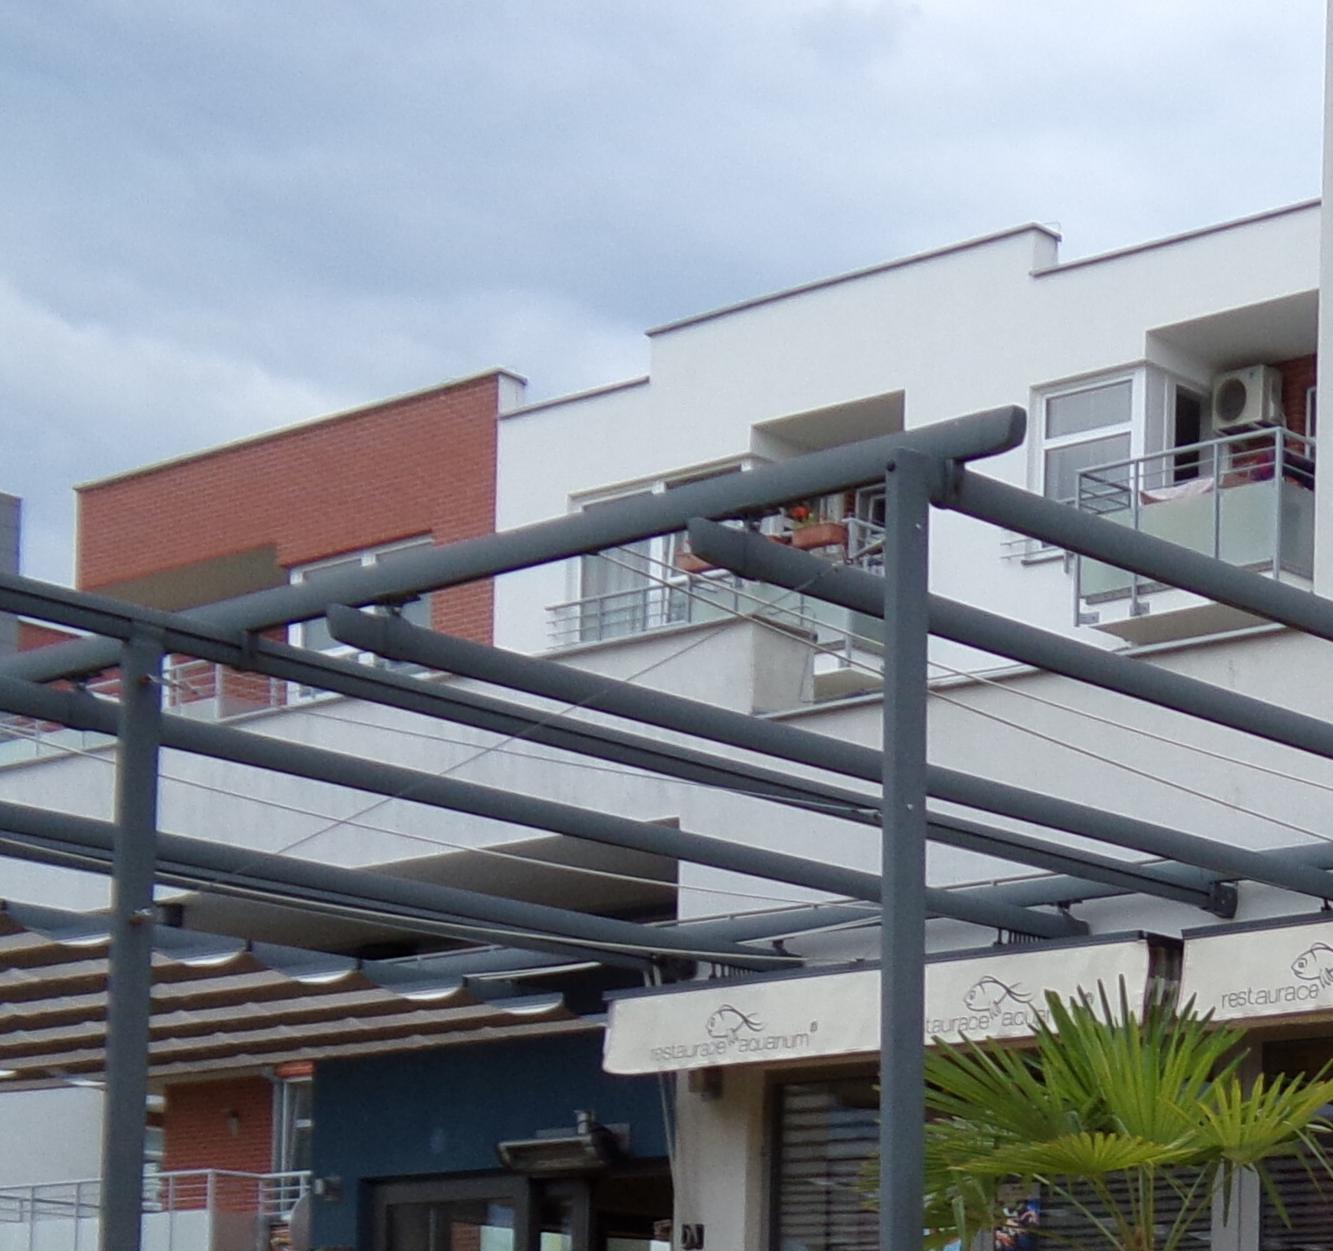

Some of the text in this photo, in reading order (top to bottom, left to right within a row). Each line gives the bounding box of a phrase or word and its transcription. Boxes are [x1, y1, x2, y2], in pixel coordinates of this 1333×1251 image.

[1221, 979, 1319, 1010] restaurace
[926, 1013, 990, 1034] taurace
[650, 1038, 727, 1061] restaurace
